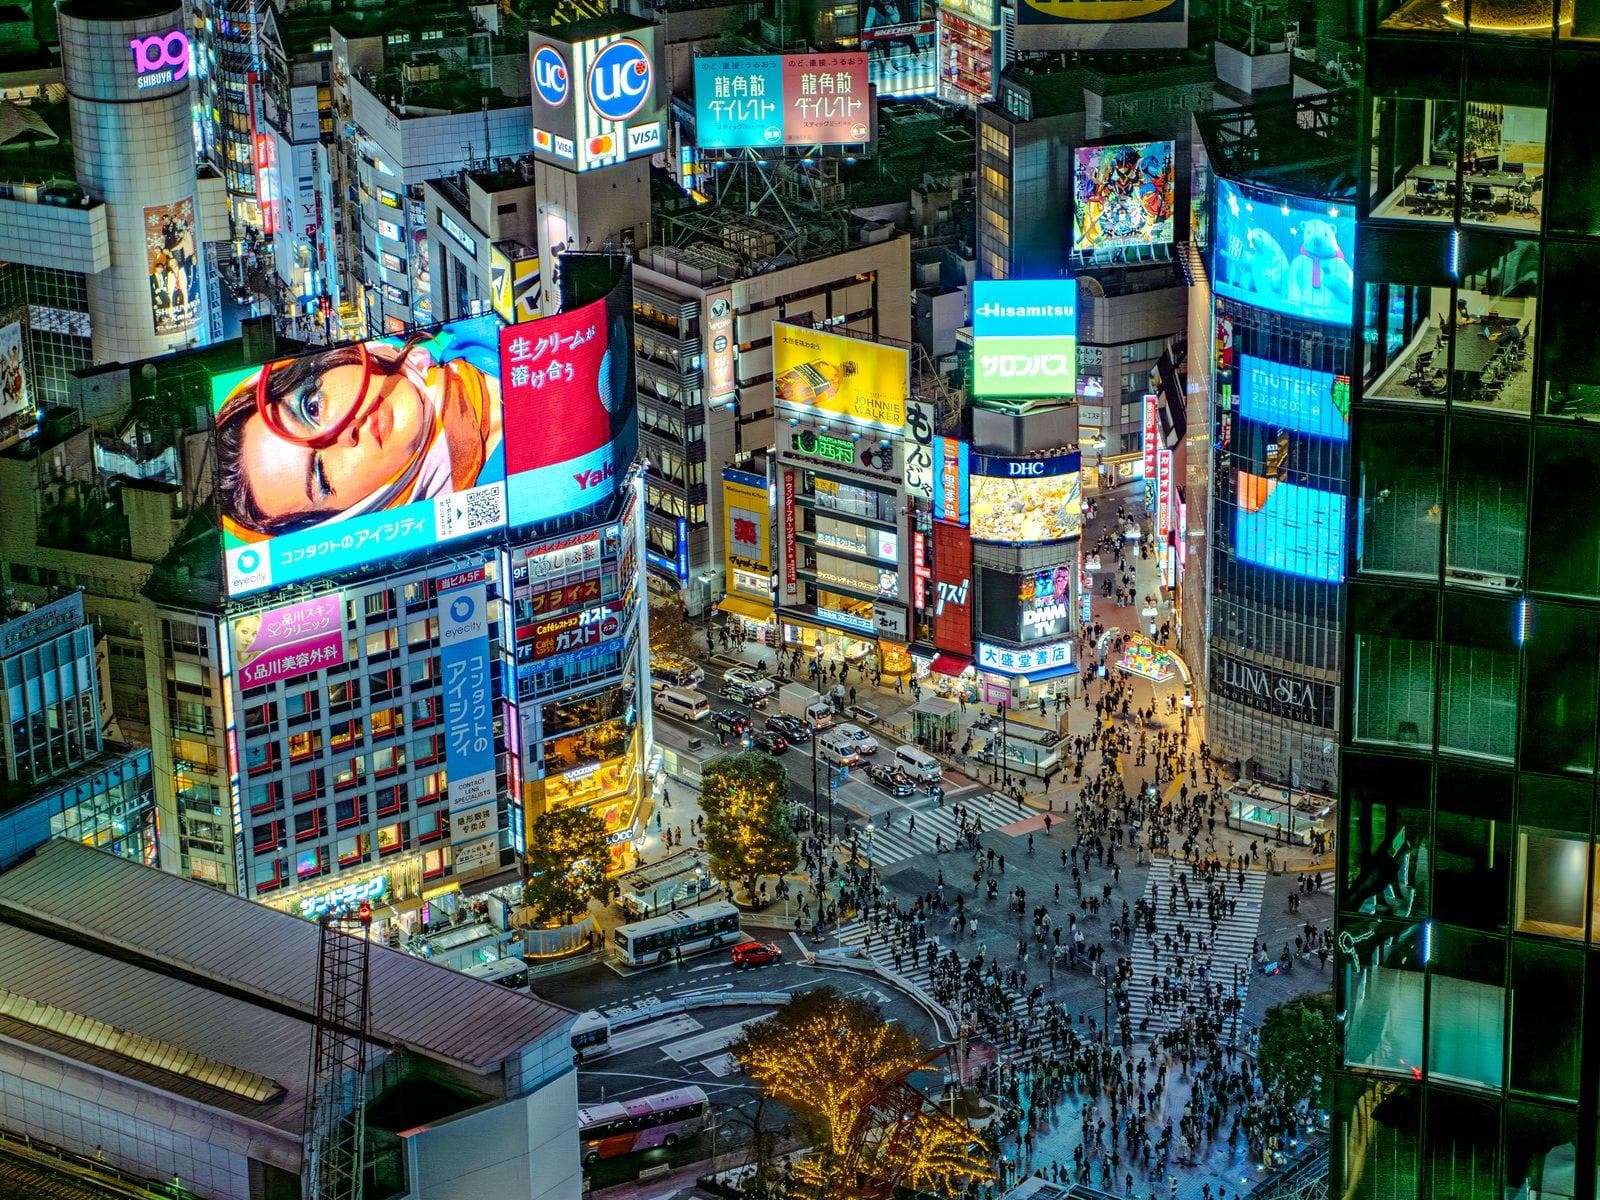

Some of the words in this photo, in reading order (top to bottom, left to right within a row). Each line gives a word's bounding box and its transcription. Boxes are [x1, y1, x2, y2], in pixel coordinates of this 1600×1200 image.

[130, 31, 188, 80] 109
[138, 71, 172, 88] SHIBUYA
[536, 59, 566, 92] UC
[595, 59, 646, 101] UC
[715, 75, 765, 98] 龍角散
[802, 73, 852, 96] 龍角散
[708, 99, 776, 121] ダイレクト
[795, 96, 862, 119] ダイレクト
[557, 140, 573, 154] VISA
[632, 129, 658, 146] VISA
[976, 303, 1073, 317] Hisamitsu
[509, 326, 596, 361] 生クリームが
[511, 359, 575, 387] 溶け合う
[980, 354, 1069, 377] サロンパス
[855, 396, 899, 414] JOHNNIE
[855, 405, 899, 423] WALKER
[820, 442, 854, 464] 西村
[907, 403, 932, 497] もんじゃ
[1009, 462, 1044, 475] DHC
[280, 517, 426, 566] コンタクトのアイシティ
[234, 572, 265, 588] eyecity
[442, 570, 480, 591] 当ビル5F
[513, 566, 526, 579] 9F
[282, 603, 335, 625] 品川スキン
[580, 606, 612, 625] ガスト
[1023, 603, 1066, 626] DMM
[283, 617, 330, 638] クリニック
[446, 622, 482, 638] eyecity
[1035, 620, 1055, 637] TV
[556, 627, 596, 651] ガスト
[254, 645, 338, 679] 品川美容外科
[517, 644, 532, 658] 7F
[985, 646, 1064, 668] 大盛堂書店
[1224, 659, 1272, 698] LUNA
[1275, 678, 1317, 710] SEA
[448, 660, 471, 756] アイシティ
[471, 655, 488, 753] コンタクトの
[459, 778, 485, 791] CONTACT
[465, 787, 480, 796] LENS
[455, 790, 491, 804] SPECIALISTS
